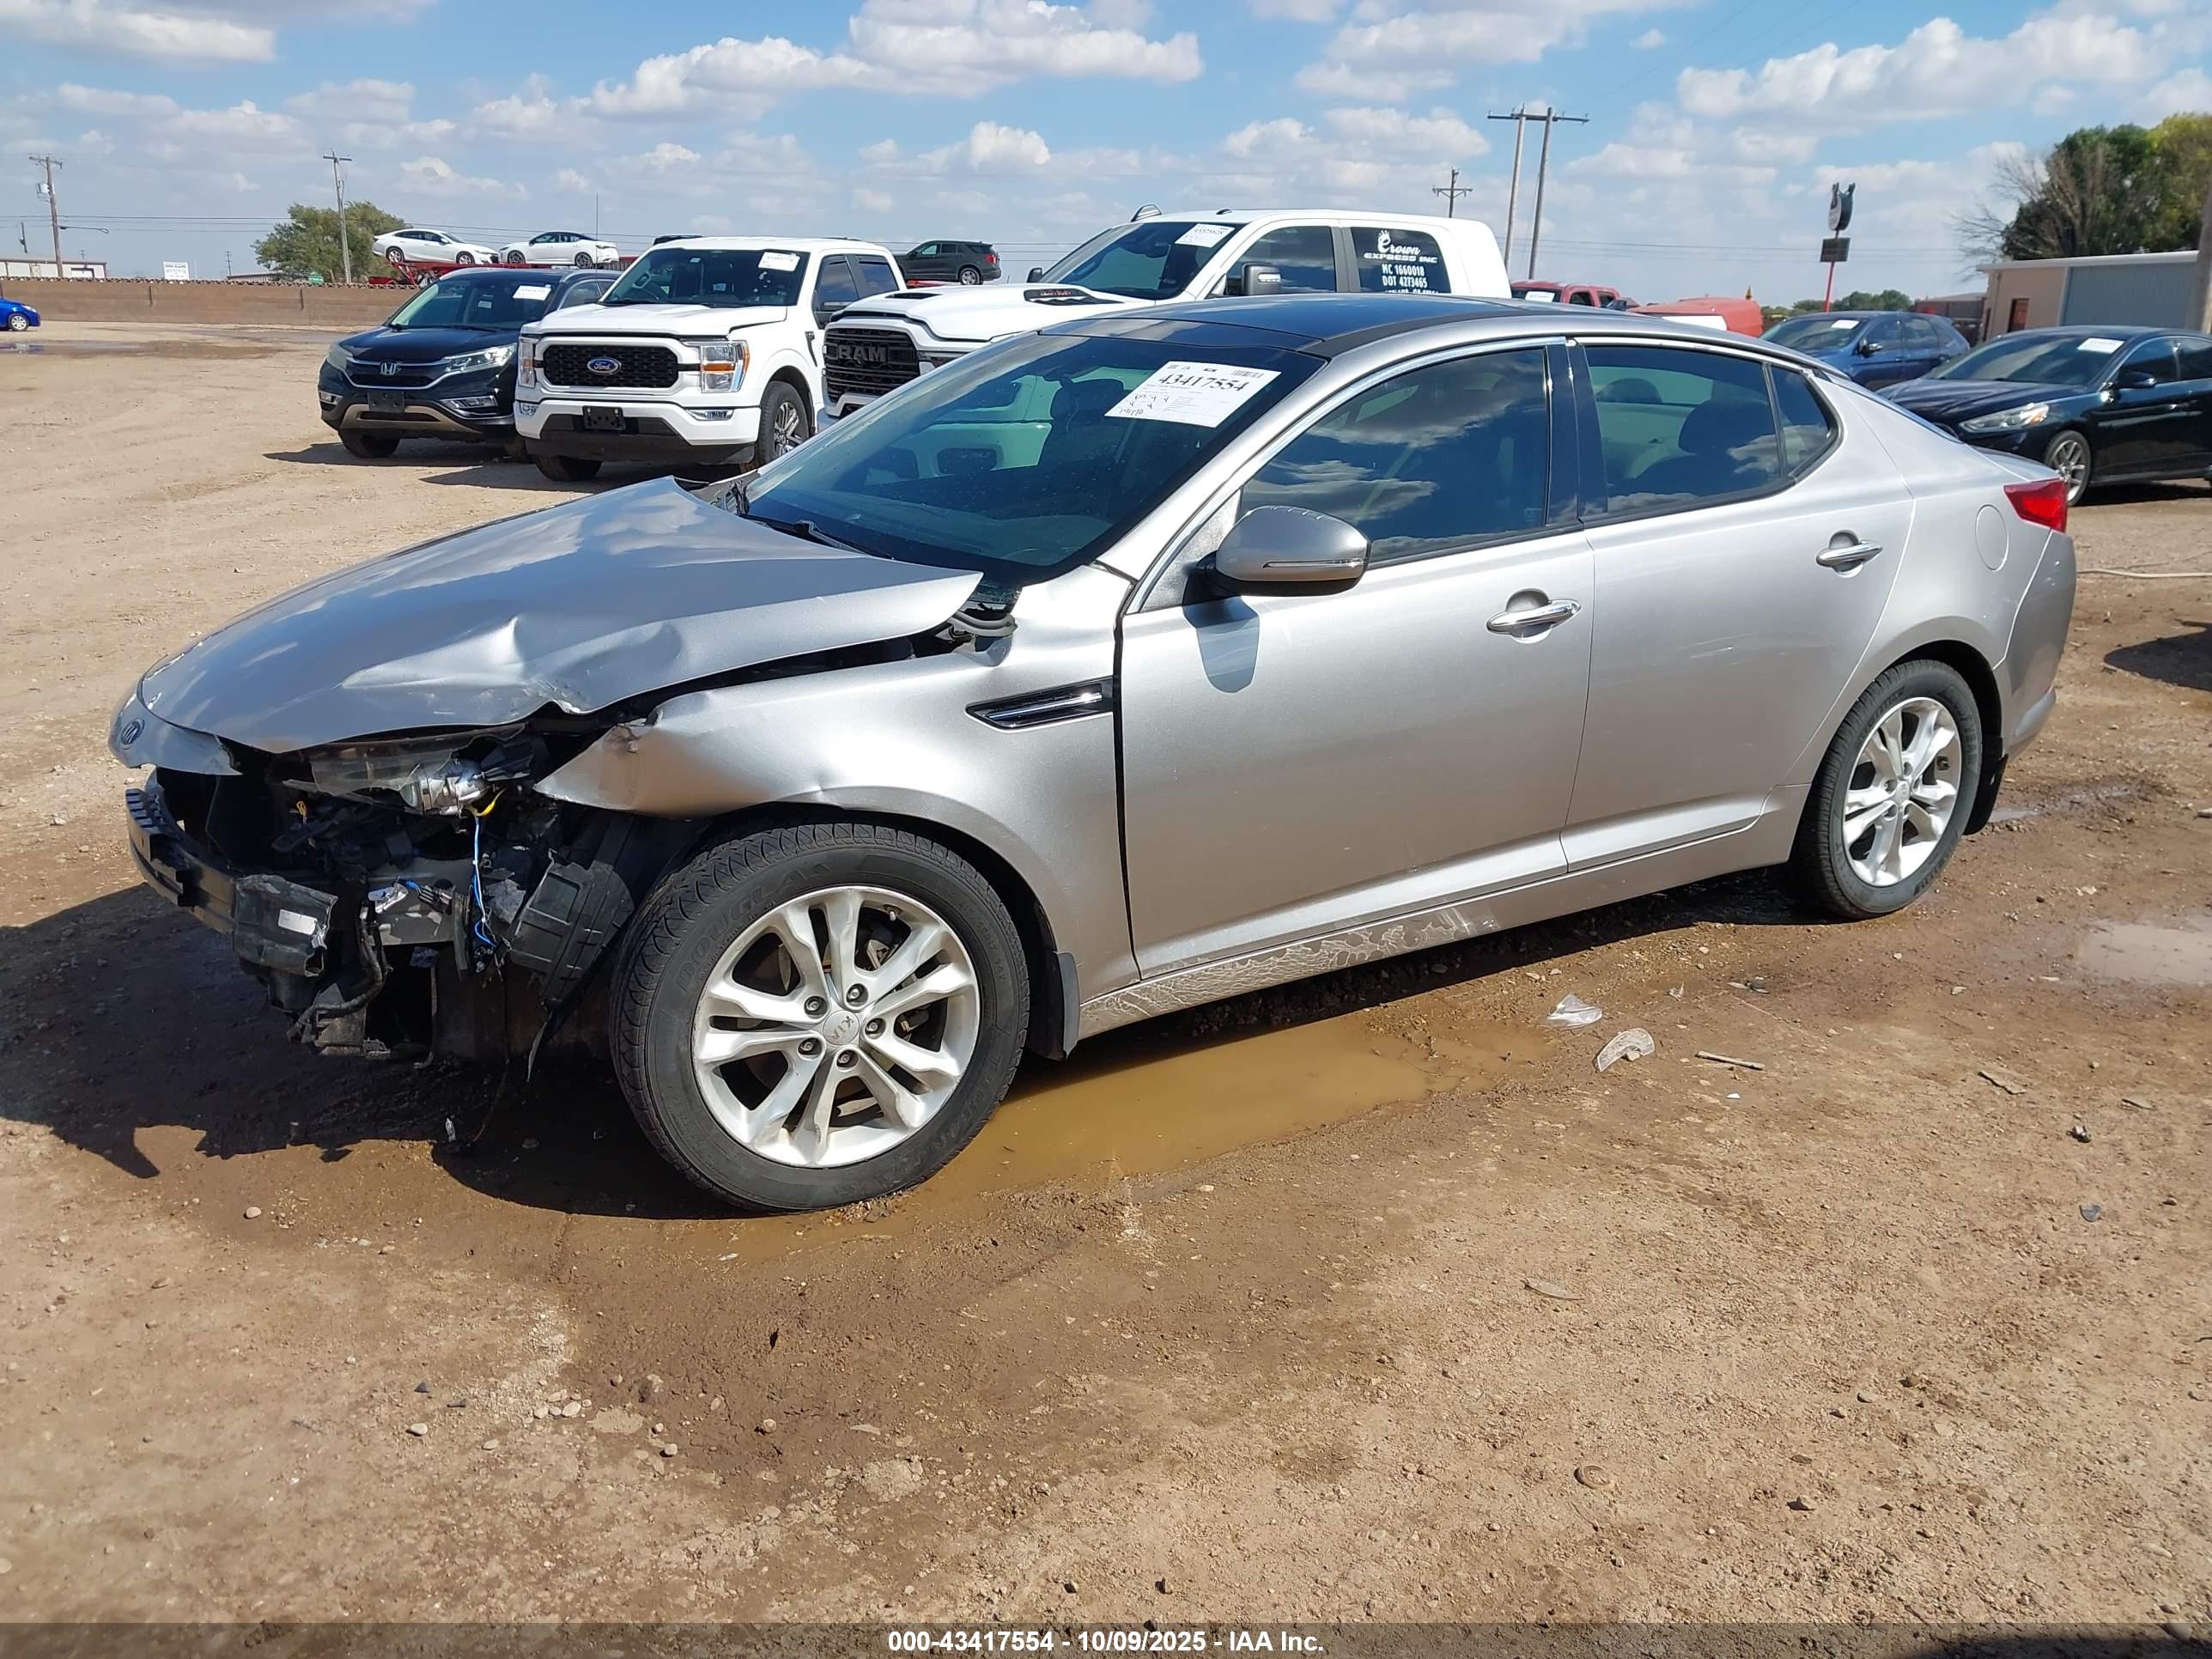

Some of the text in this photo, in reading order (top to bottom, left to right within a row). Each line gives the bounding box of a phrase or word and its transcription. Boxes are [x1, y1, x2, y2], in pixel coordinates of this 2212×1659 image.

[1377, 230, 1421, 255] Crown
[1364, 252, 1417, 262] EXPRESS
[1382, 275, 1396, 286] DOT
[838, 344, 887, 362] RAM
[593, 362, 611, 370] Ford
[1158, 373, 1249, 392] 43417554
